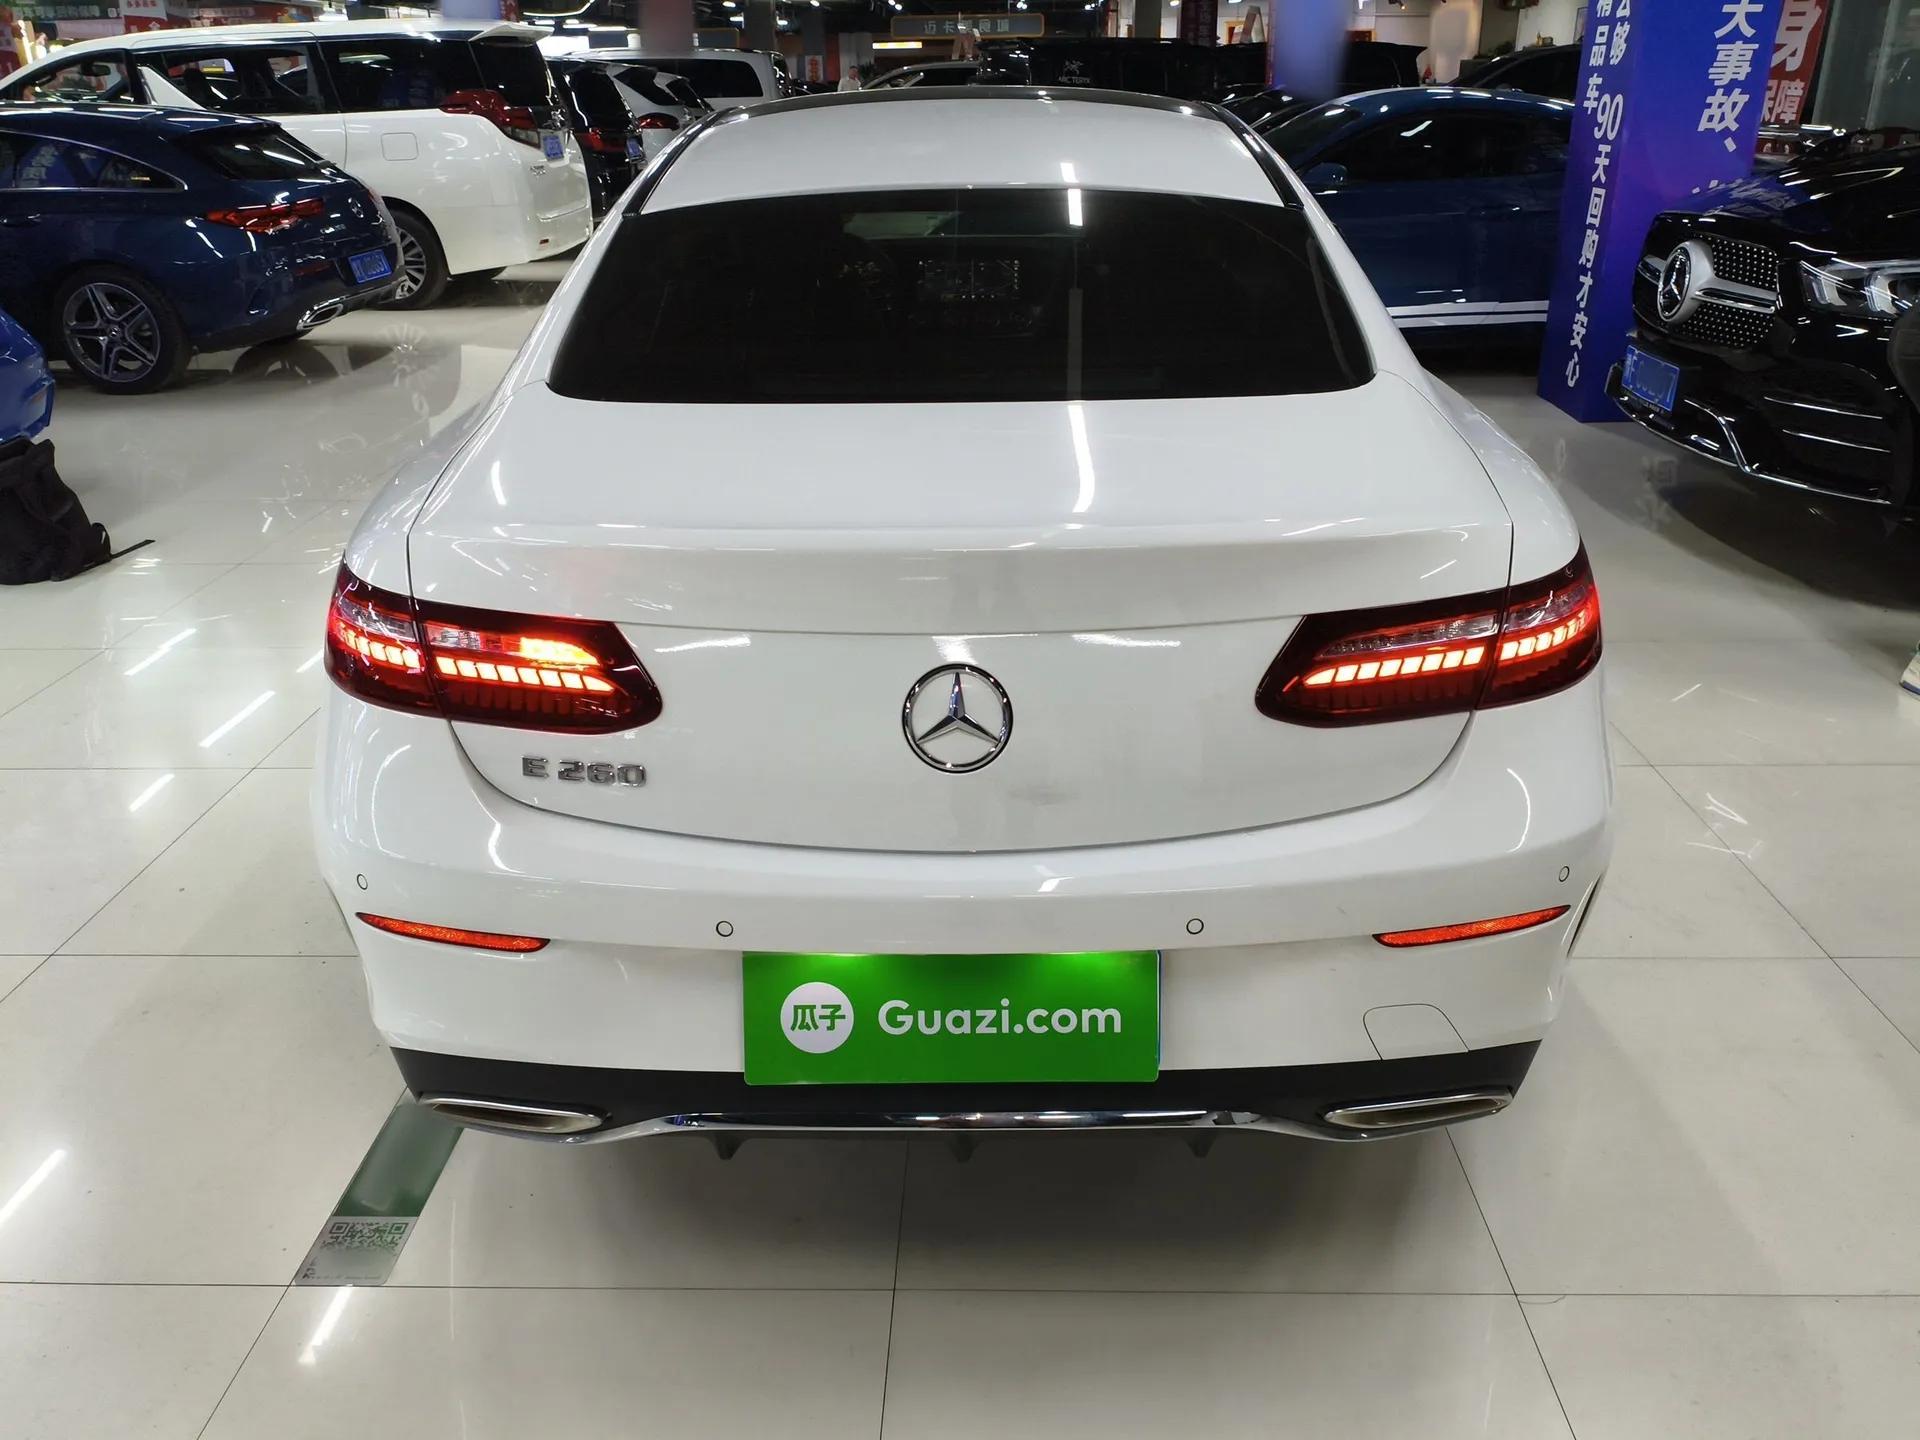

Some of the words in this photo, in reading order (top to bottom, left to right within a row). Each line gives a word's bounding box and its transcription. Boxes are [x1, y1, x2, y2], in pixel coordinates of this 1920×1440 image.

[1692, 0, 1762, 193] 大事故、
[521, 756, 549, 778] E
[557, 759, 647, 787] 260
[790, 1004, 847, 1032] 瓜子
[877, 998, 1122, 1035] Guazi.com
